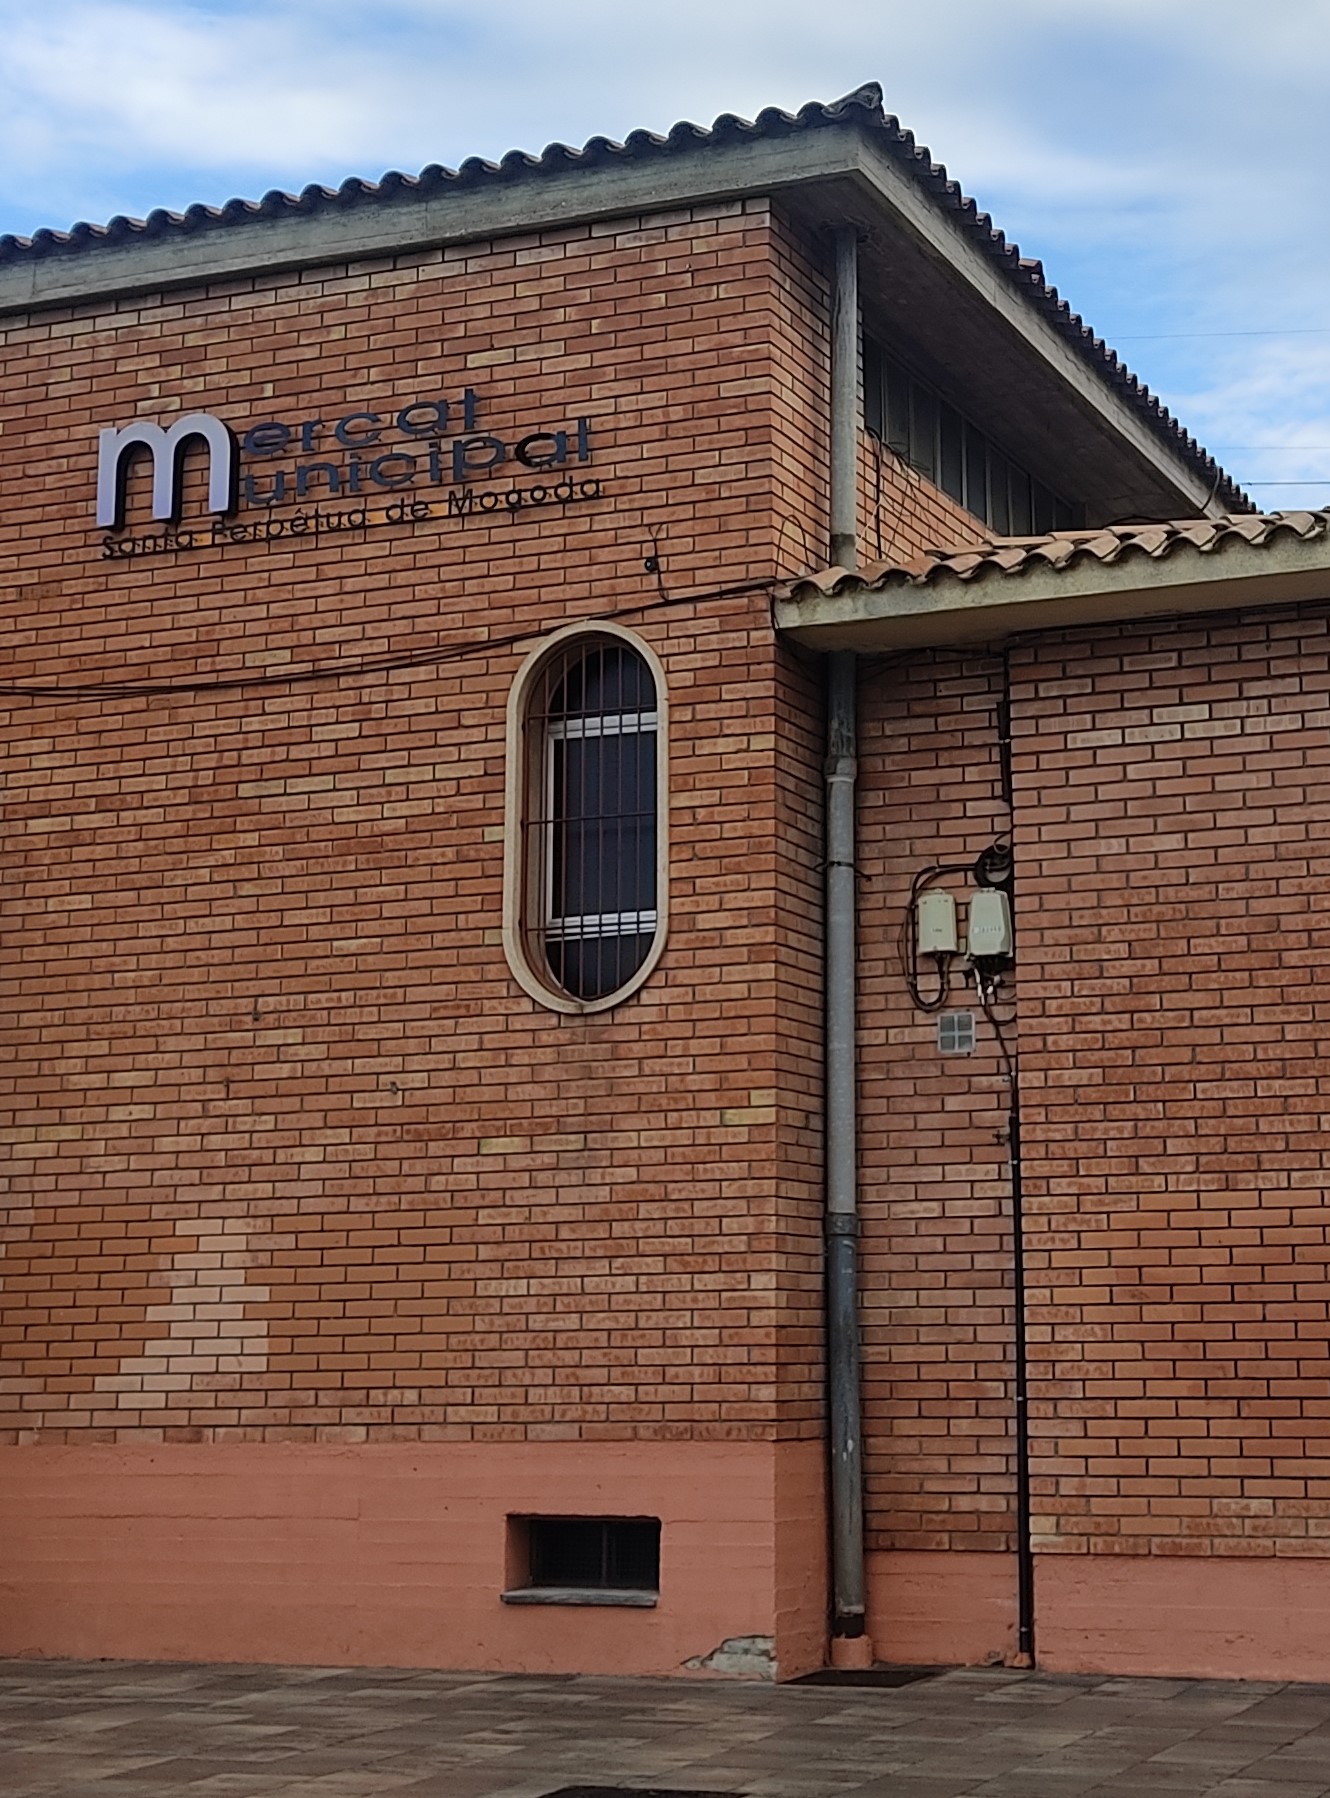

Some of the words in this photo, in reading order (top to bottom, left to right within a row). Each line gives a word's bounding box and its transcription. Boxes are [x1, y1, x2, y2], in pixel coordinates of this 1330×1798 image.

[101, 526, 196, 560] Santa
[385, 497, 430, 522] de
[448, 475, 602, 515] Mogoda
